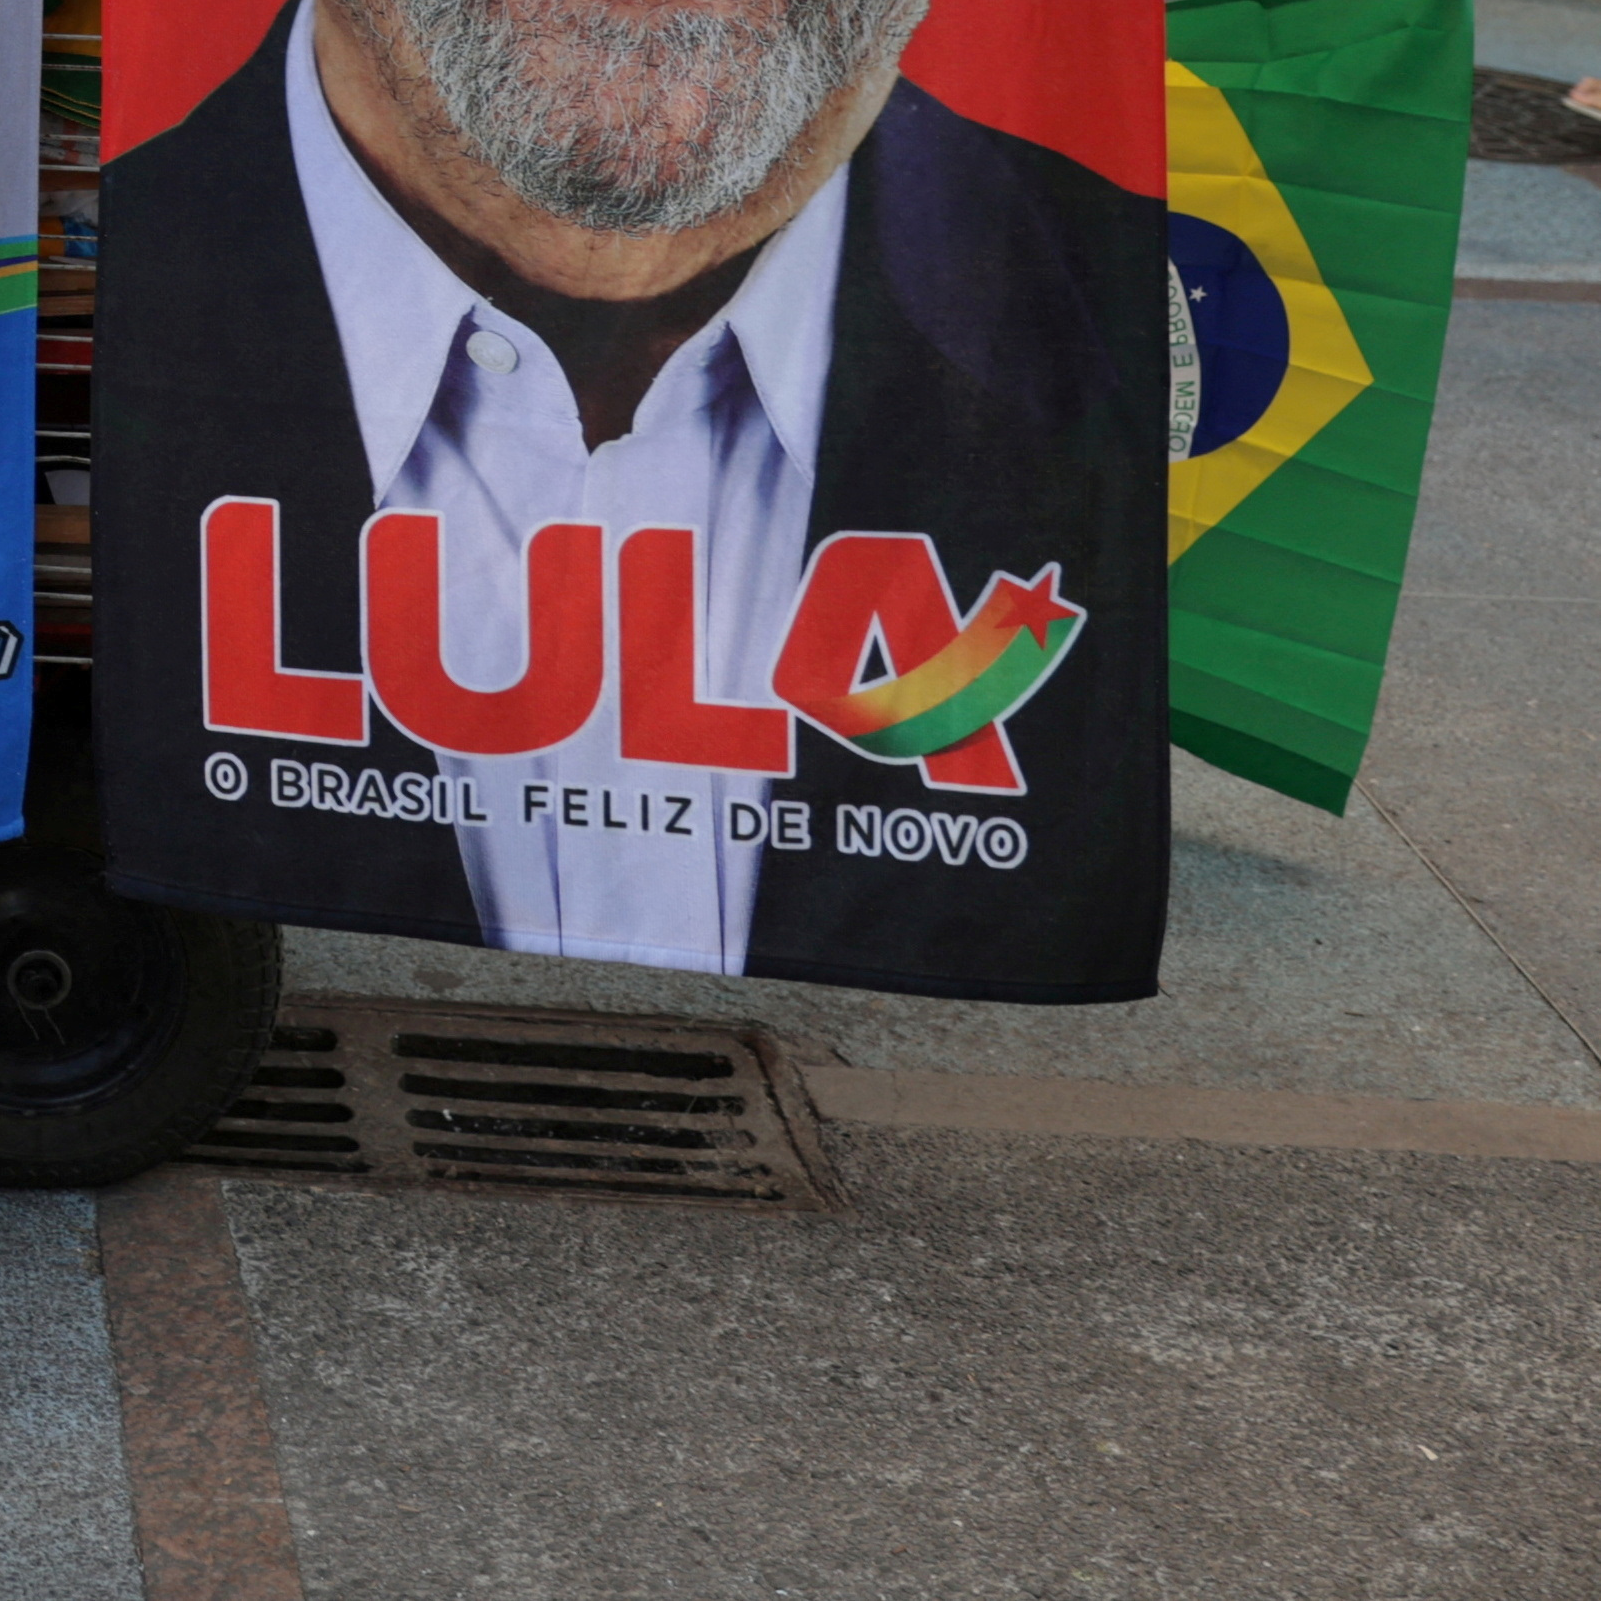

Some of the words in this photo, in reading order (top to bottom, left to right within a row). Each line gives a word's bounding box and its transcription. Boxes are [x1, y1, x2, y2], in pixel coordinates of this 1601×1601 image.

[201, 495, 1028, 797] LULA
[205, 753, 246, 799] O
[271, 759, 489, 823] BRASIL
[522, 785, 695, 837] FELIZ
[729, 802, 811, 849] DE
[837, 805, 1028, 868] NOVO
